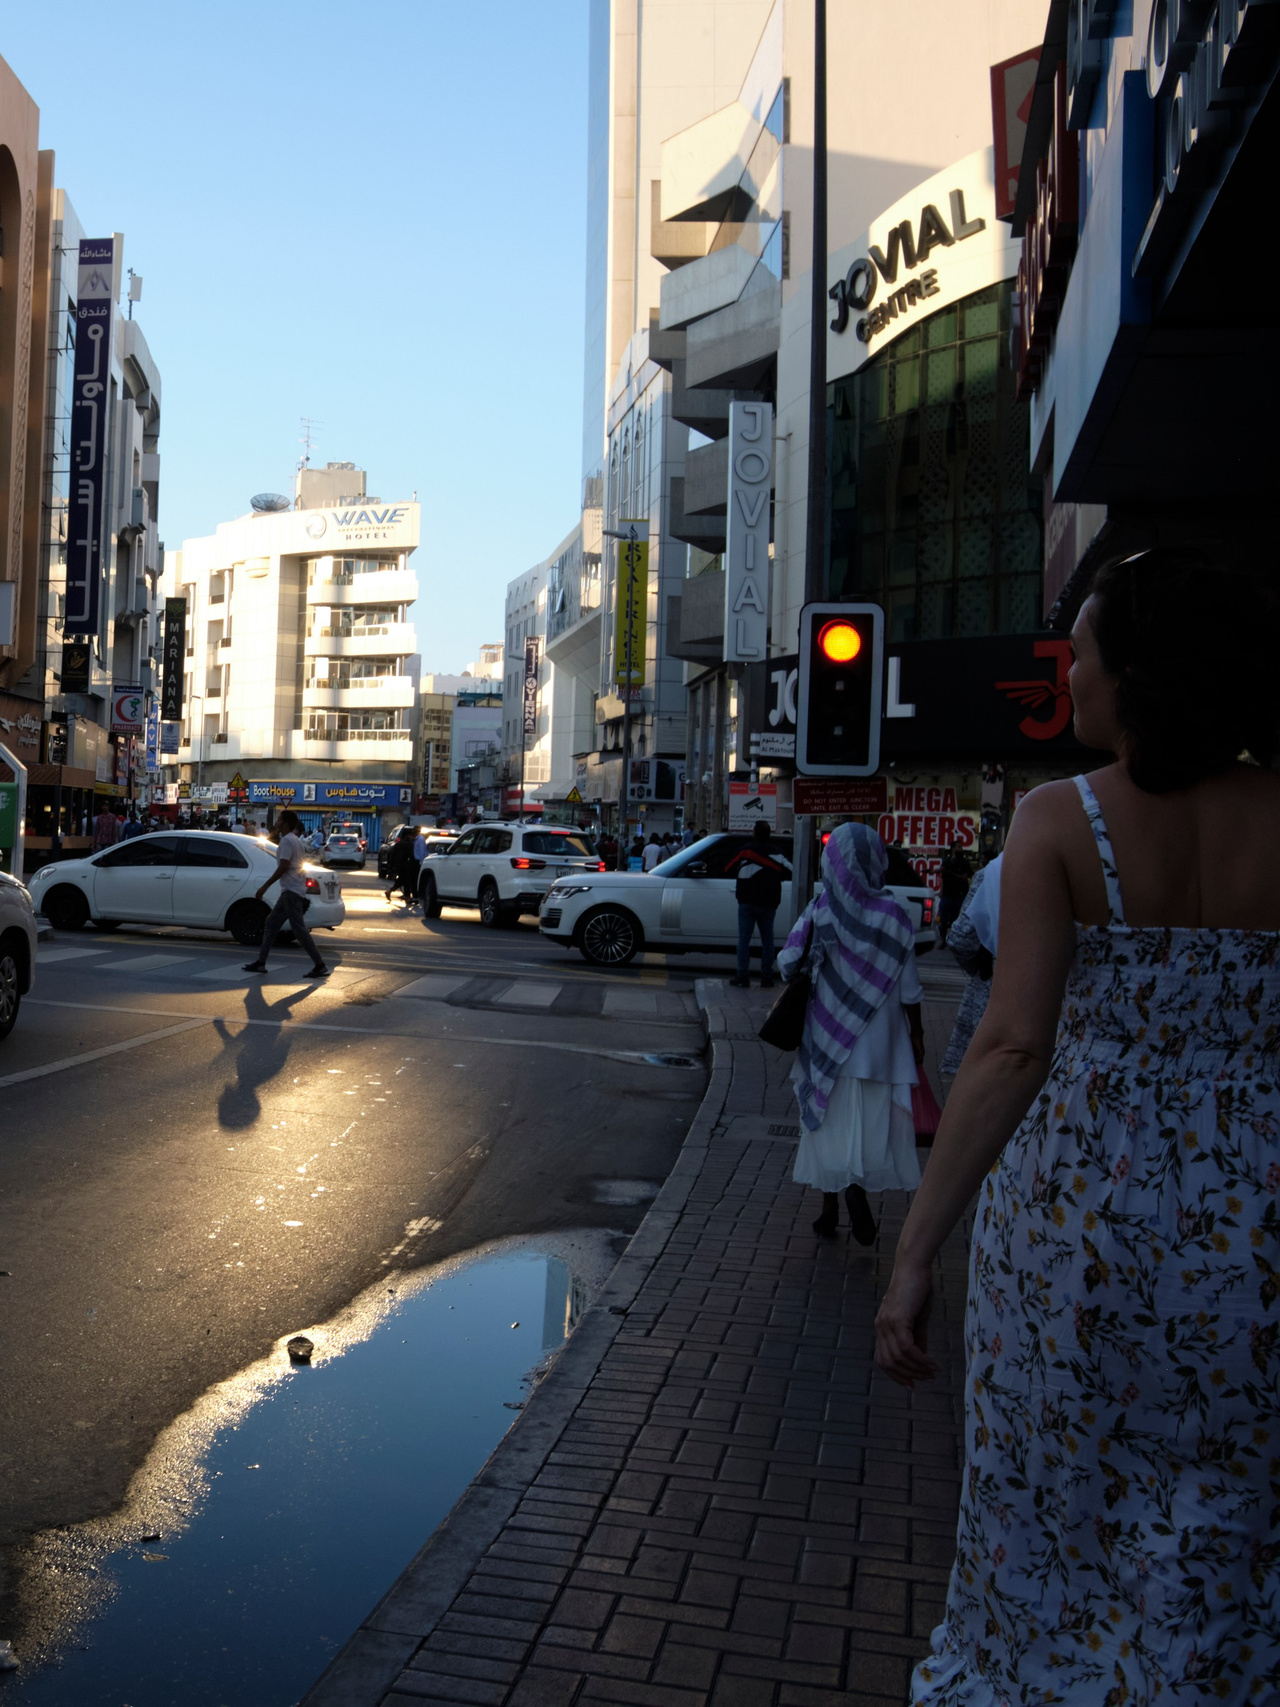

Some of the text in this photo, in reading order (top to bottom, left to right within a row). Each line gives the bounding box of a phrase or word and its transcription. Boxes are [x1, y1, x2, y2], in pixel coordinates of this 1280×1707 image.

[829, 188, 981, 331] JOVIAL
[79, 307, 108, 318] فندق
[855, 267, 936, 341] CENTRE
[332, 507, 409, 526] WAVE
[733, 404, 770, 657] JOVIAL
[345, 532, 388, 540] HOTEL
[167, 622, 179, 709] MARIANA
[525, 688, 536, 726] VIENNA
[113, 724, 141, 732] PHARMACY
[325, 786, 386, 799] بوت هاوس
[894, 787, 957, 812] MEGA
[879, 815, 974, 847] OFFERS
